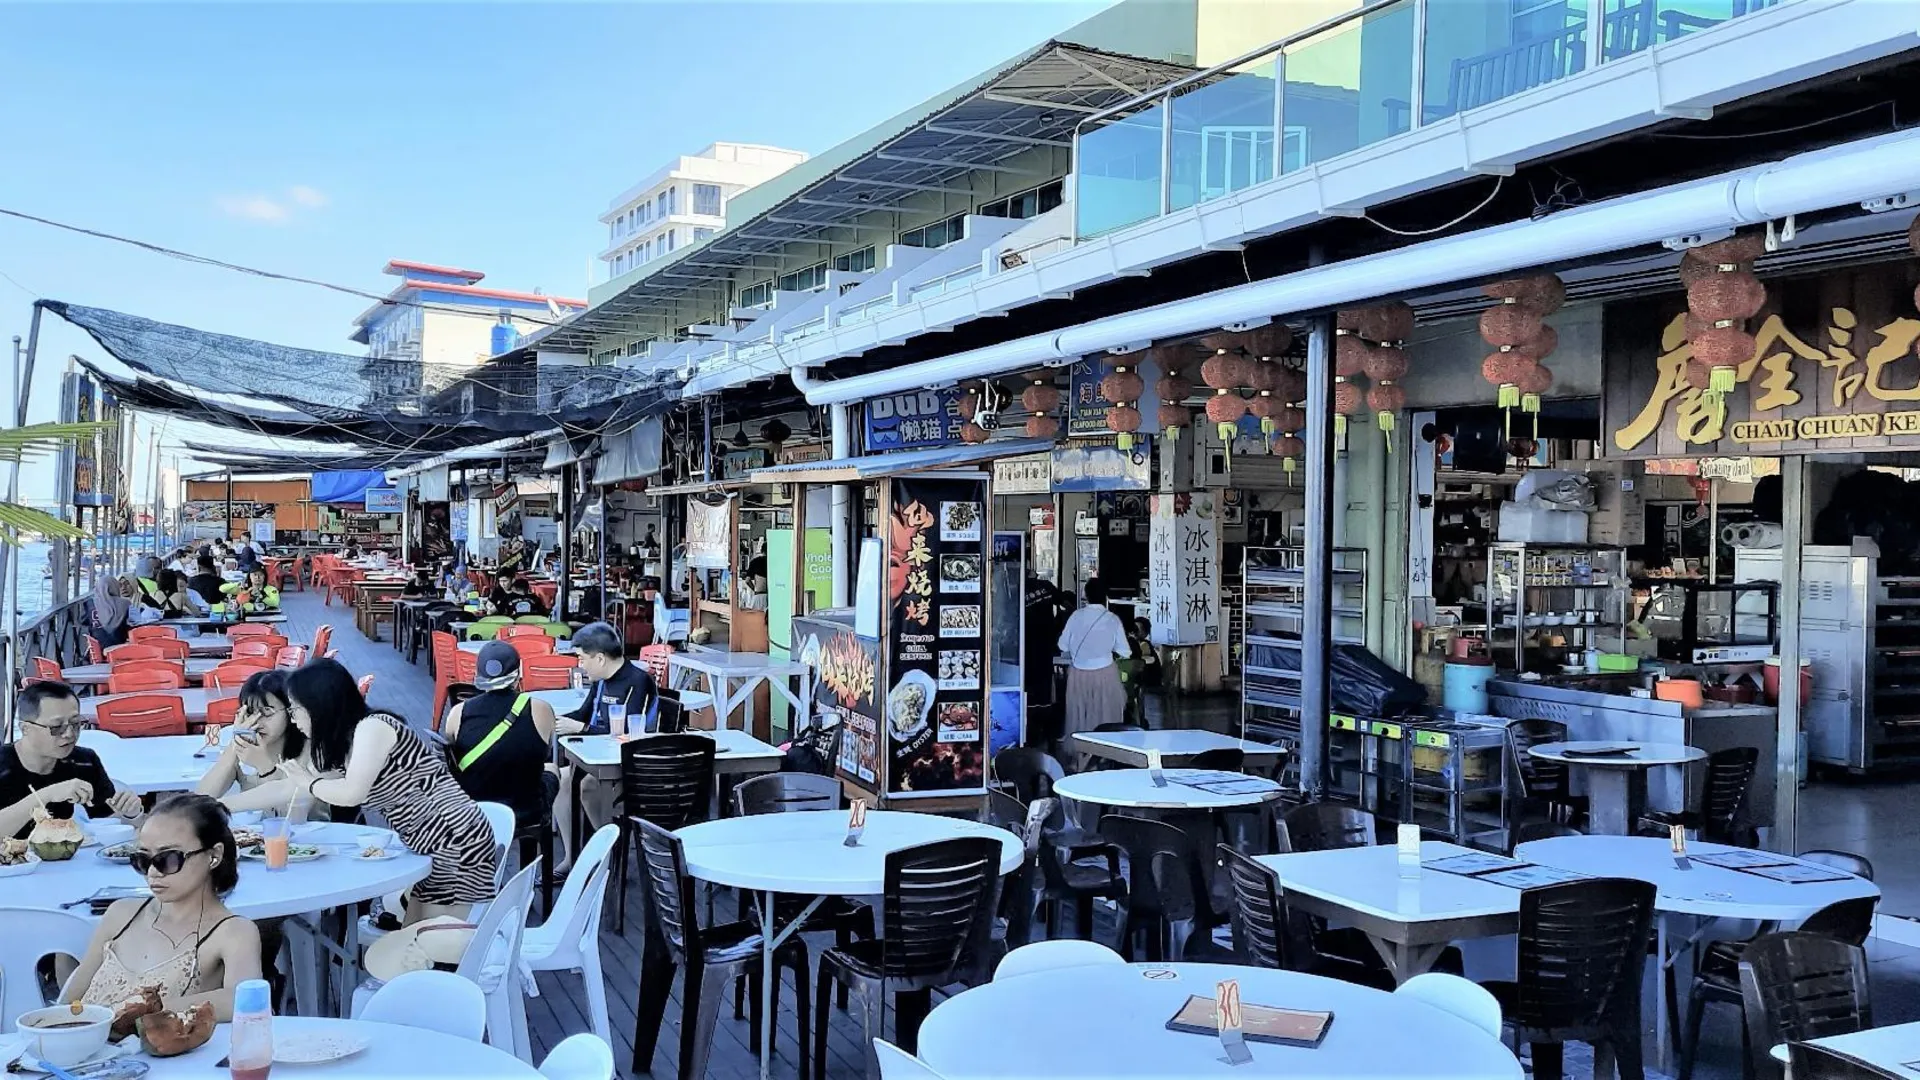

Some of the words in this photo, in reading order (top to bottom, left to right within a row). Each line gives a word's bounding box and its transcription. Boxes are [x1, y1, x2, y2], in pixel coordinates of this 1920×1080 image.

[1733, 424, 1790, 439] CHAM
[1799, 417, 1875, 434] CHUAN
[1154, 524, 1173, 624] 冰淇淋
[1184, 523, 1213, 624] 冰淇淋
[912, 727, 934, 749] OYSTER
